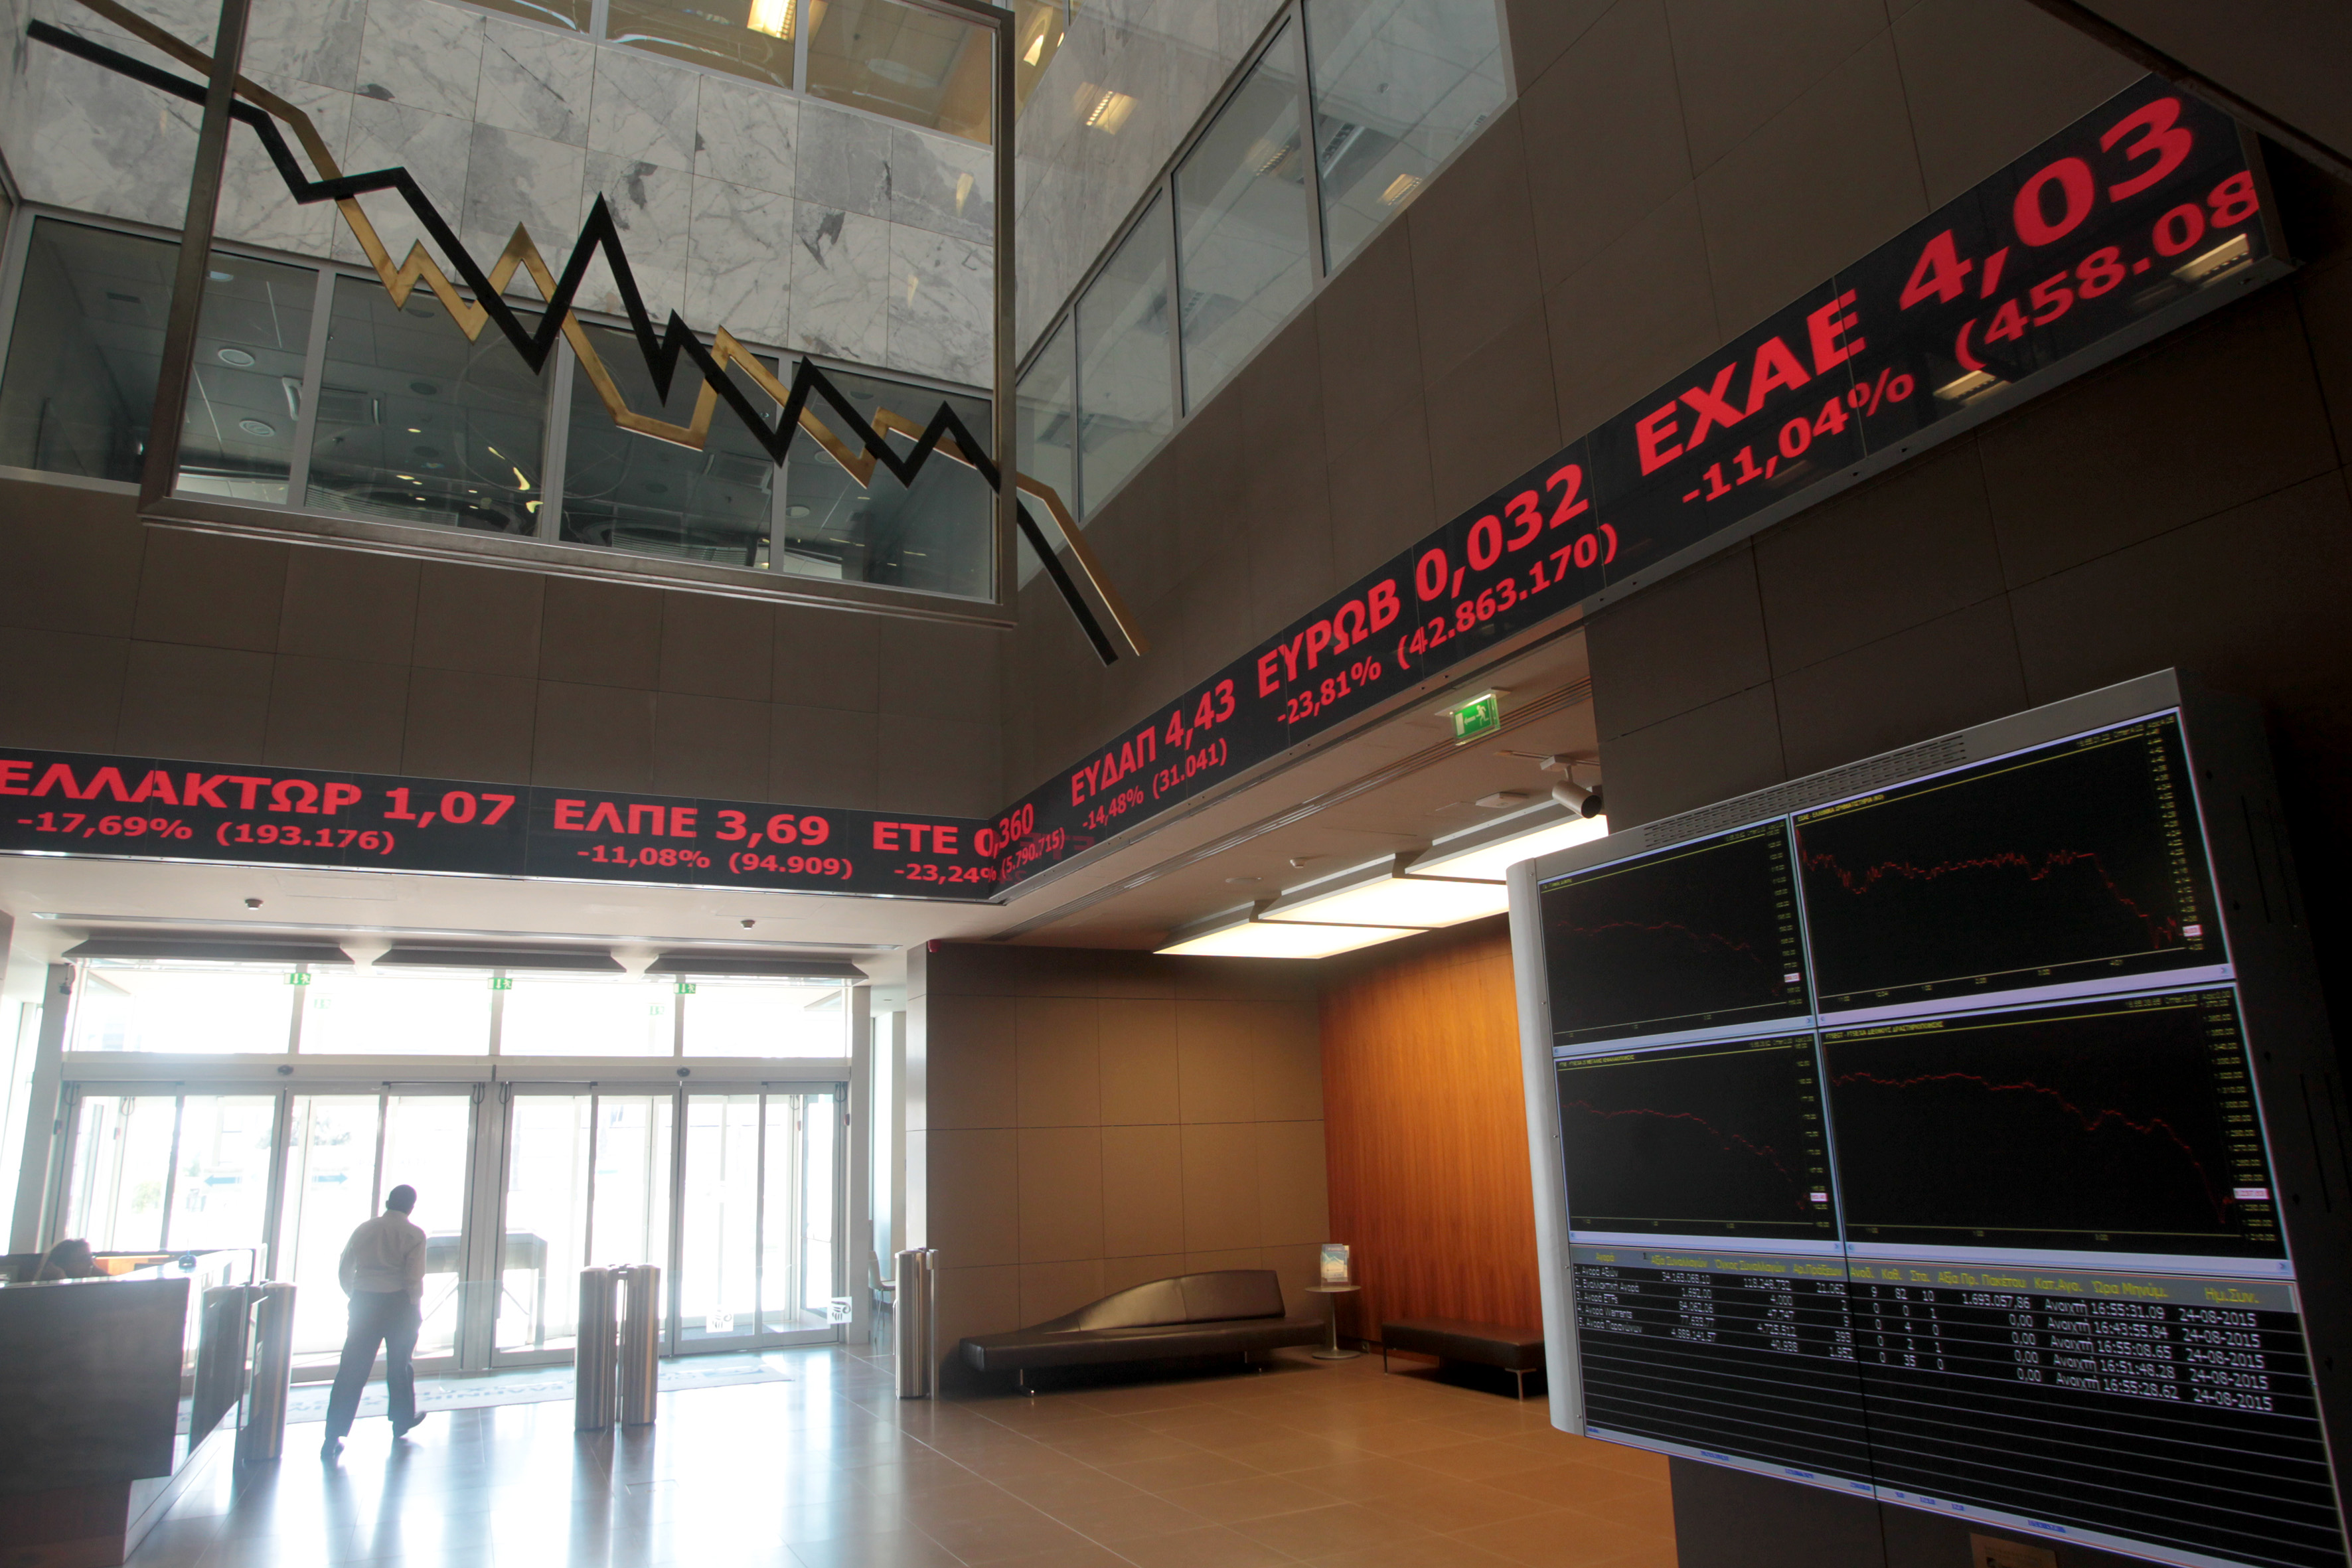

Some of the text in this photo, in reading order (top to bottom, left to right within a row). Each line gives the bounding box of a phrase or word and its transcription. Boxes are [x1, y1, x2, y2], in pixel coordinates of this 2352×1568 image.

[1636, 98, 2191, 476] ΕΧΑΕ 4,03
[1683, 368, 1913, 503] -11,04%
[1258, 464, 1589, 698] ΕΥΡΩΒ 0,032
[1278, 524, 1617, 724] -23,81% (42.863.170)
[1072, 679, 1235, 806] ΕΥΔΑΠ 4,43
[1082, 738, 1227, 830] -14,48% (31.041)
[0, 760, 516, 828] ΕΛΛΑΚΤΩΡ 1,07
[554, 799, 829, 848] ΕΛΠΕ 3,69
[873, 803, 1034, 858] ΕΤΕ 0,360
[18, 812, 394, 854] -17,69% (193.176)
[578, 845, 852, 880] -11,08% (94.909)
[895, 828, 1065, 884] -23,24% (5.790.715)
[1871, 1287, 1878, 1297] 9
[1895, 1288, 1908, 1300] 82
[1922, 1291, 1934, 1302] 10
[1873, 1303, 1880, 1314] 0
[1903, 1305, 1910, 1316] 0
[1962, 1294, 2031, 1310] 1.693.057,86
[2091, 1302, 2165, 1320] 16:55:31.09
[1930, 1308, 1938, 1319] 1
[2009, 1314, 2034, 1328] 0,00
[2178, 1308, 2258, 1327] 24-08-2015
[1875, 1319, 1883, 1330] 0
[1905, 1322, 1913, 1333] 4
[1932, 1324, 1939, 1336] 0
[2094, 1320, 2169, 1340] 16:43:55.84
[1877, 1335, 1884, 1346] 0
[1907, 1338, 1915, 1350] 2
[2011, 1331, 2036, 1346] 0,00
[2182, 1328, 2261, 1348] 24-08-2015
[1934, 1342, 1942, 1353] 1
[2097, 1340, 2173, 1360] 16:55:08.65
[1879, 1352, 1887, 1363] 0
[1903, 1354, 1917, 1367] 35
[1937, 1358, 1944, 1370] 0
[2014, 1350, 2039, 1364] 0,00
[2185, 1348, 2265, 1370] 24-08-2015
[2016, 1368, 2041, 1381] 0,00
[2100, 1359, 2176, 1379] 16:51:48.28
[2189, 1368, 2269, 1390] 24-08-2015
[2103, 1378, 2180, 1400] 16:55:28.62
[2193, 1388, 2273, 1411] 24-08-2015
